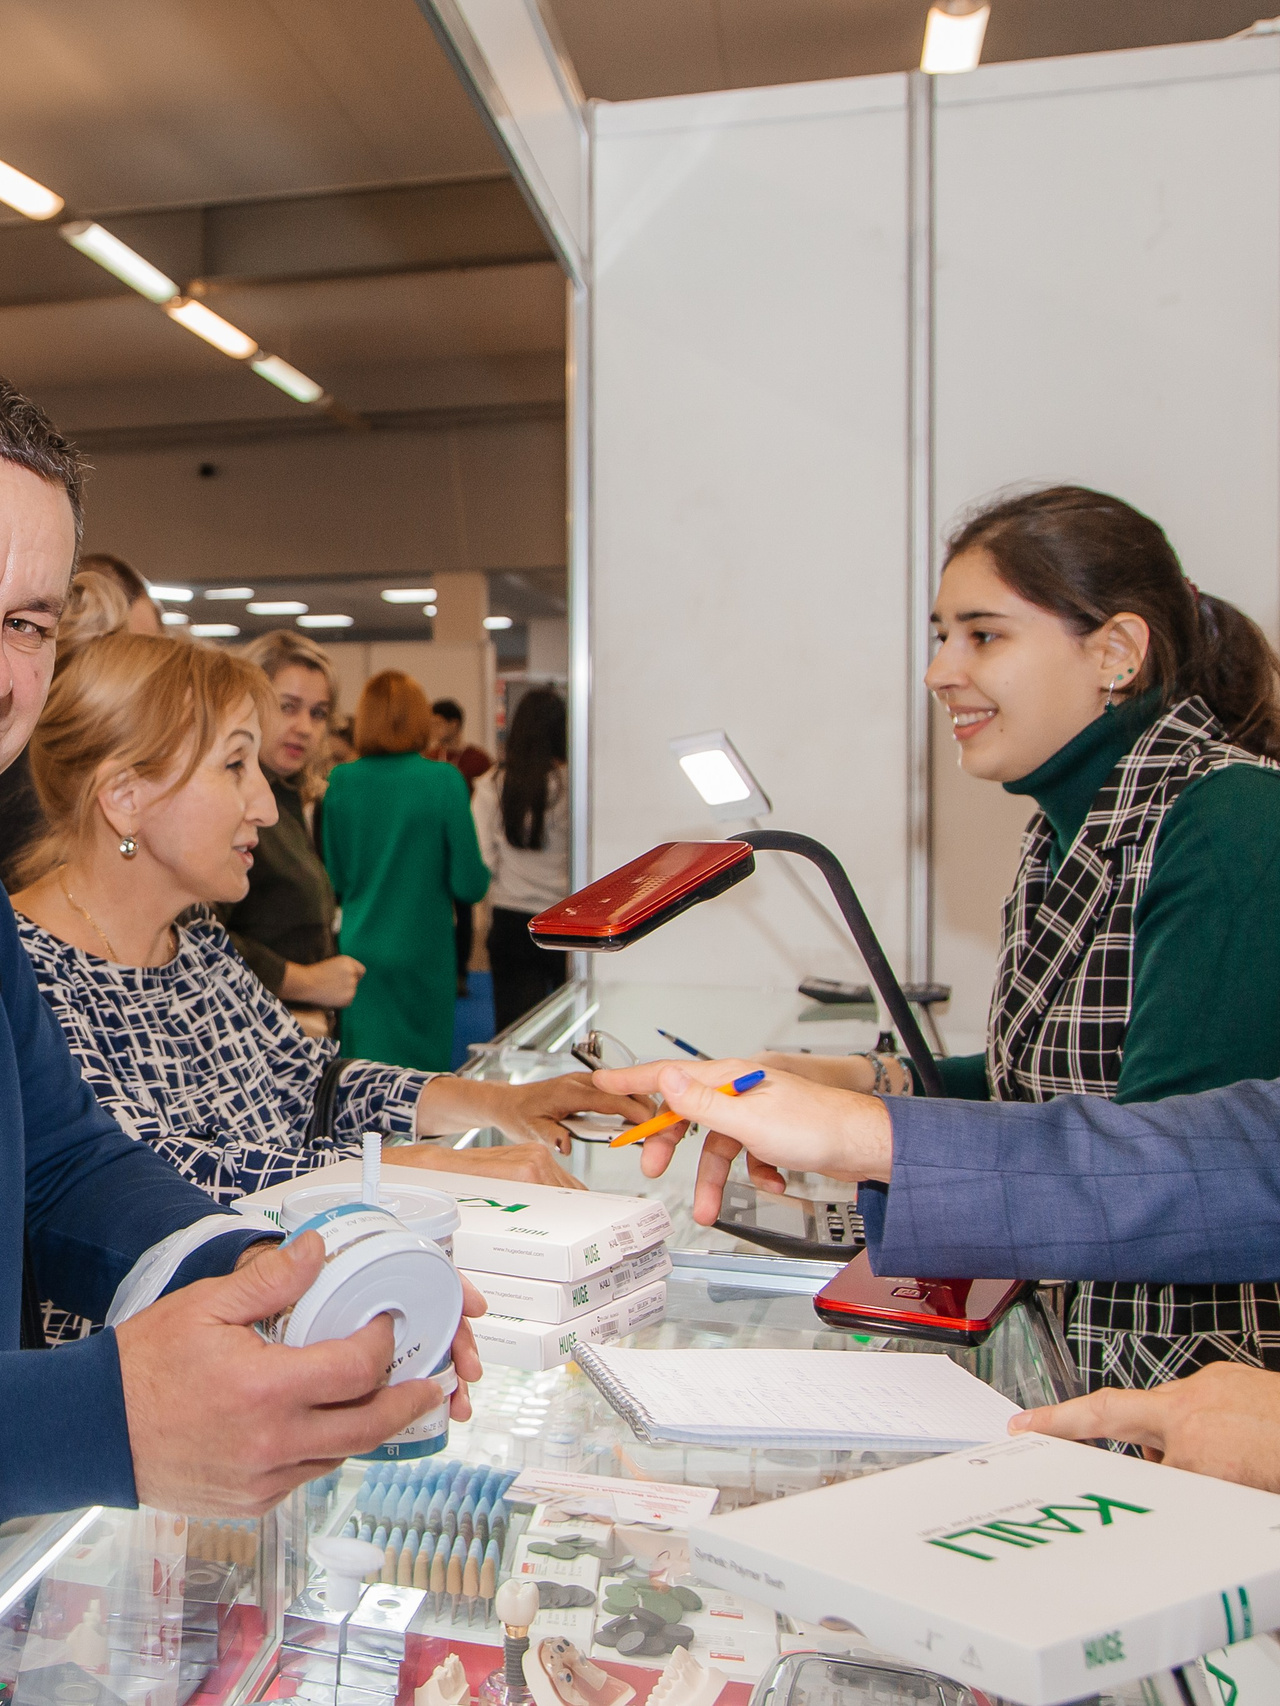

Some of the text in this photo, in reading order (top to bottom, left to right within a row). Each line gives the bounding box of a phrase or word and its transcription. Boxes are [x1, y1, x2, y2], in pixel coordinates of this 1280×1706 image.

[322, 1227, 339, 1240] SIZ
[505, 1226, 549, 1236] HUGE
[492, 1246, 544, 1258] www.hugedental.com
[583, 1243, 601, 1267] HUGE
[483, 1288, 534, 1302] www.hugedental.com
[572, 1284, 589, 1308] HUGE
[406, 1343, 421, 1358] A2
[422, 1423, 437, 1433] SIZE
[923, 1492, 1155, 1562] KAILI
